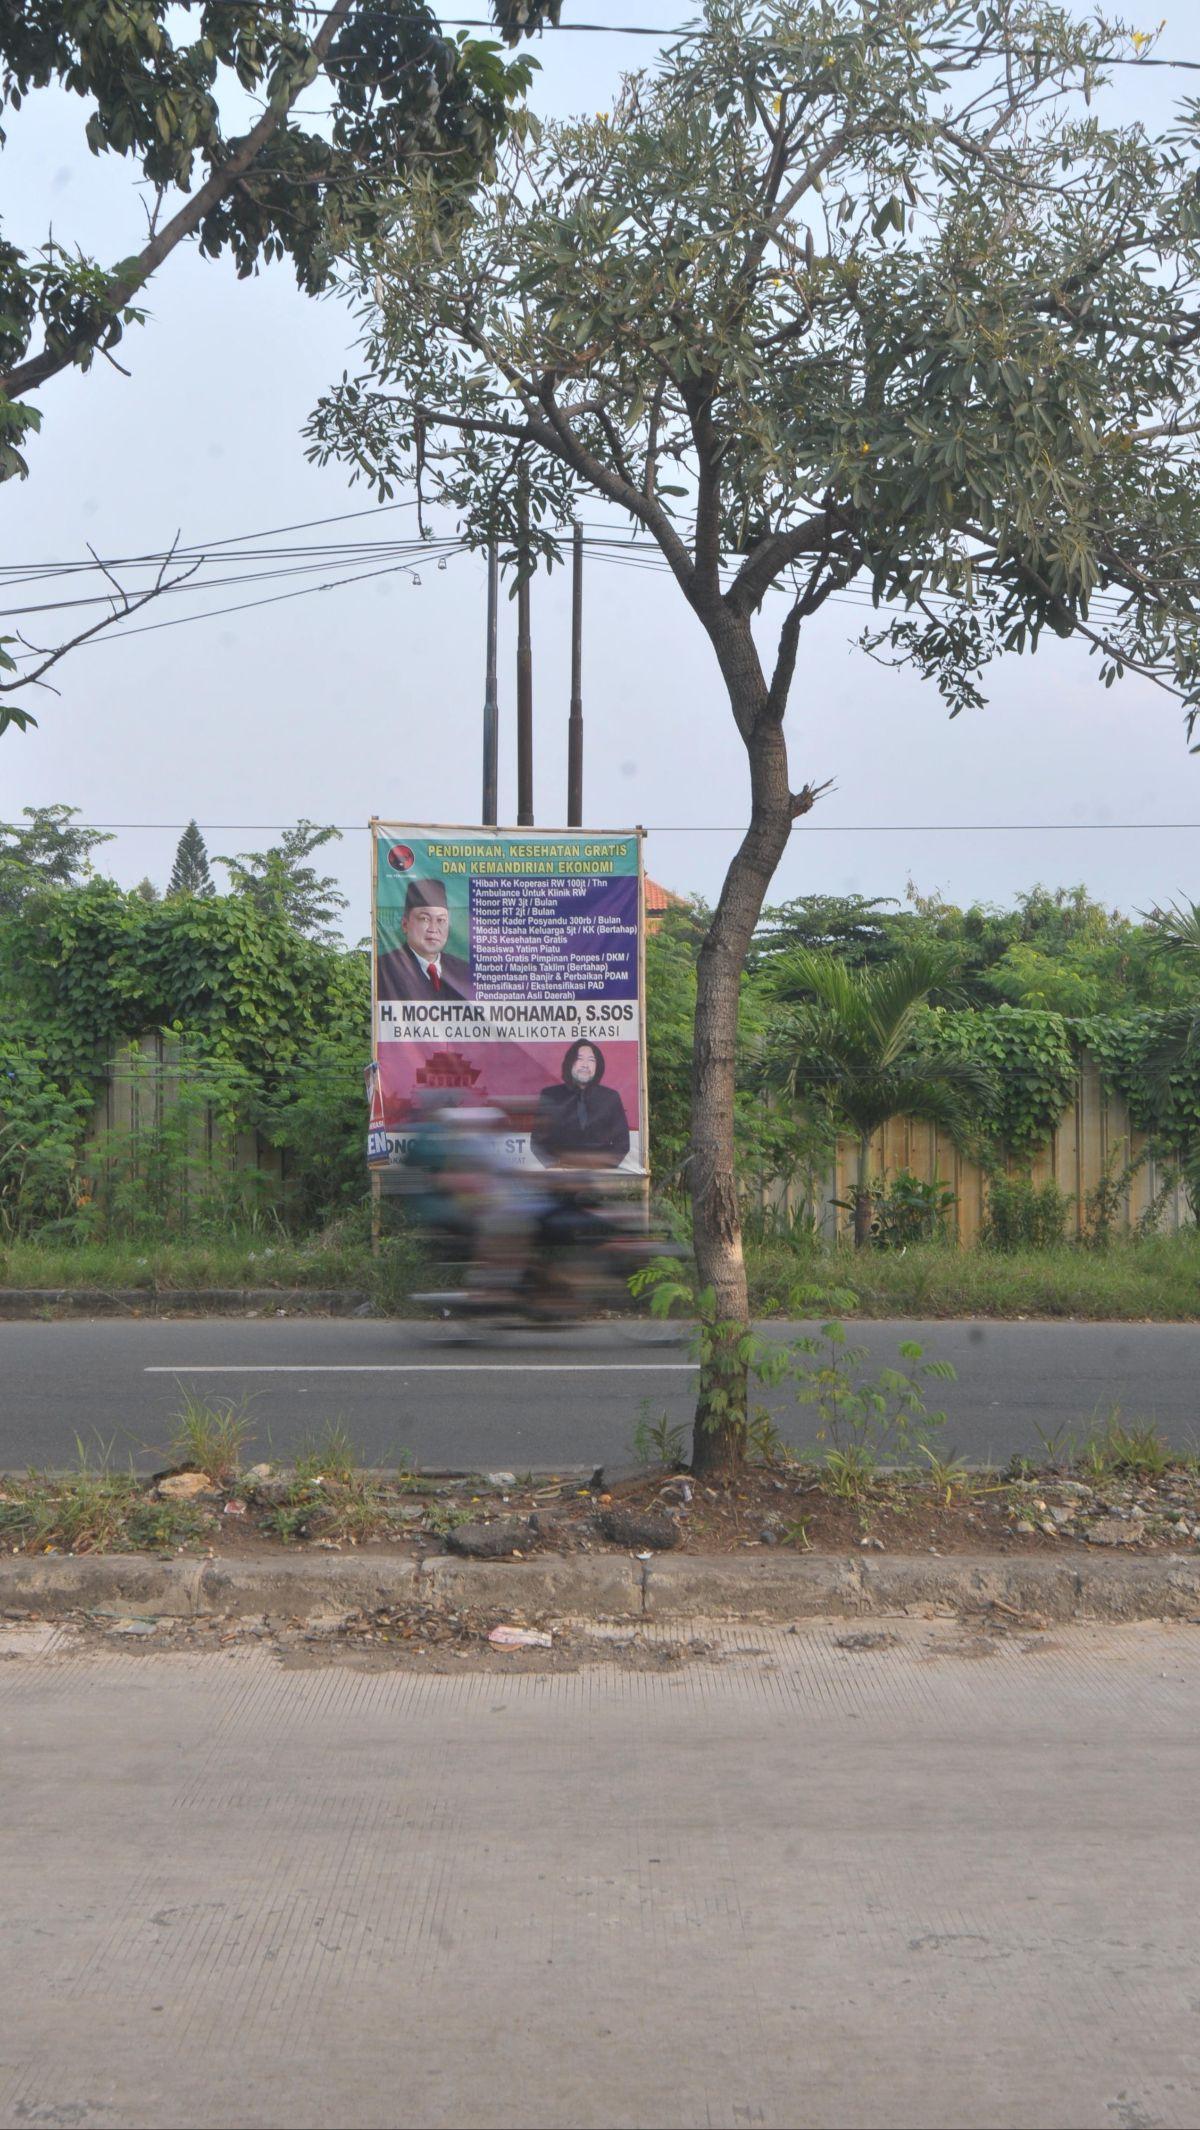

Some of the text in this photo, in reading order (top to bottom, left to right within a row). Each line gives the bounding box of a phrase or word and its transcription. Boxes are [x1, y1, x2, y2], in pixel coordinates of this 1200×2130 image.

[428, 844, 627, 858] PENDIDIKAN, KESEHATAN GRATIS
[442, 861, 613, 873] DAN KEMANDIRIAN EKONOMI
[500, 879, 512, 887] Ke
[513, 879, 549, 889] Koperasi
[551, 879, 565, 887] RW
[567, 879, 586, 889] 100jt
[592, 879, 608, 887] Thn
[522, 888, 546, 897] Untuk
[547, 888, 571, 897] Klinik
[572, 888, 587, 897] RW
[502, 898, 516, 906] RW
[518, 898, 528, 908] 3jt
[534, 898, 558, 906] Bulan
[502, 907, 514, 916] RT
[516, 907, 526, 917] 2jt
[532, 907, 555, 916] Bulan
[502, 917, 526, 925] Kader
[527, 916, 568, 926] Posyandu
[569, 916, 592, 925] 300rb
[597, 916, 621, 924] Bulan
[502, 926, 527, 934] Usaha
[529, 926, 565, 936] Keluarga
[566, 925, 576, 936] 5jt
[582, 925, 595, 934] KK
[597, 925, 638, 935] (Bertahap)
[500, 935, 542, 944] Kesehatan
[543, 935, 568, 944] Gratis
[516, 944, 538, 953] Yatim
[540, 944, 560, 953] Piatu
[505, 954, 529, 962] Gratis
[530, 954, 569, 963] Pimpinan
[570, 953, 600, 963] Ponpes
[606, 952, 625, 961] DKM
[475, 963, 504, 972] Marbot
[509, 963, 537, 973] Majelis
[539, 963, 565, 972] Taklim
[567, 962, 608, 972] (Bertahap)
[529, 972, 554, 983] Banjir
[563, 972, 603, 981] Perbaikan
[604, 971, 629, 980] PDAM
[530, 981, 586, 990] Ekstensifikasi
[587, 981, 605, 990] PAD
[475, 991, 576, 1000] (Pendapatan Asli Daerah)
[381, 1005, 634, 1025] H. MOCHTAR MOHAMAD, S.SOS
[394, 1025, 620, 1038] BAKAL CALON WALIKOTA BEKASI
[505, 1139, 526, 1153] ST
